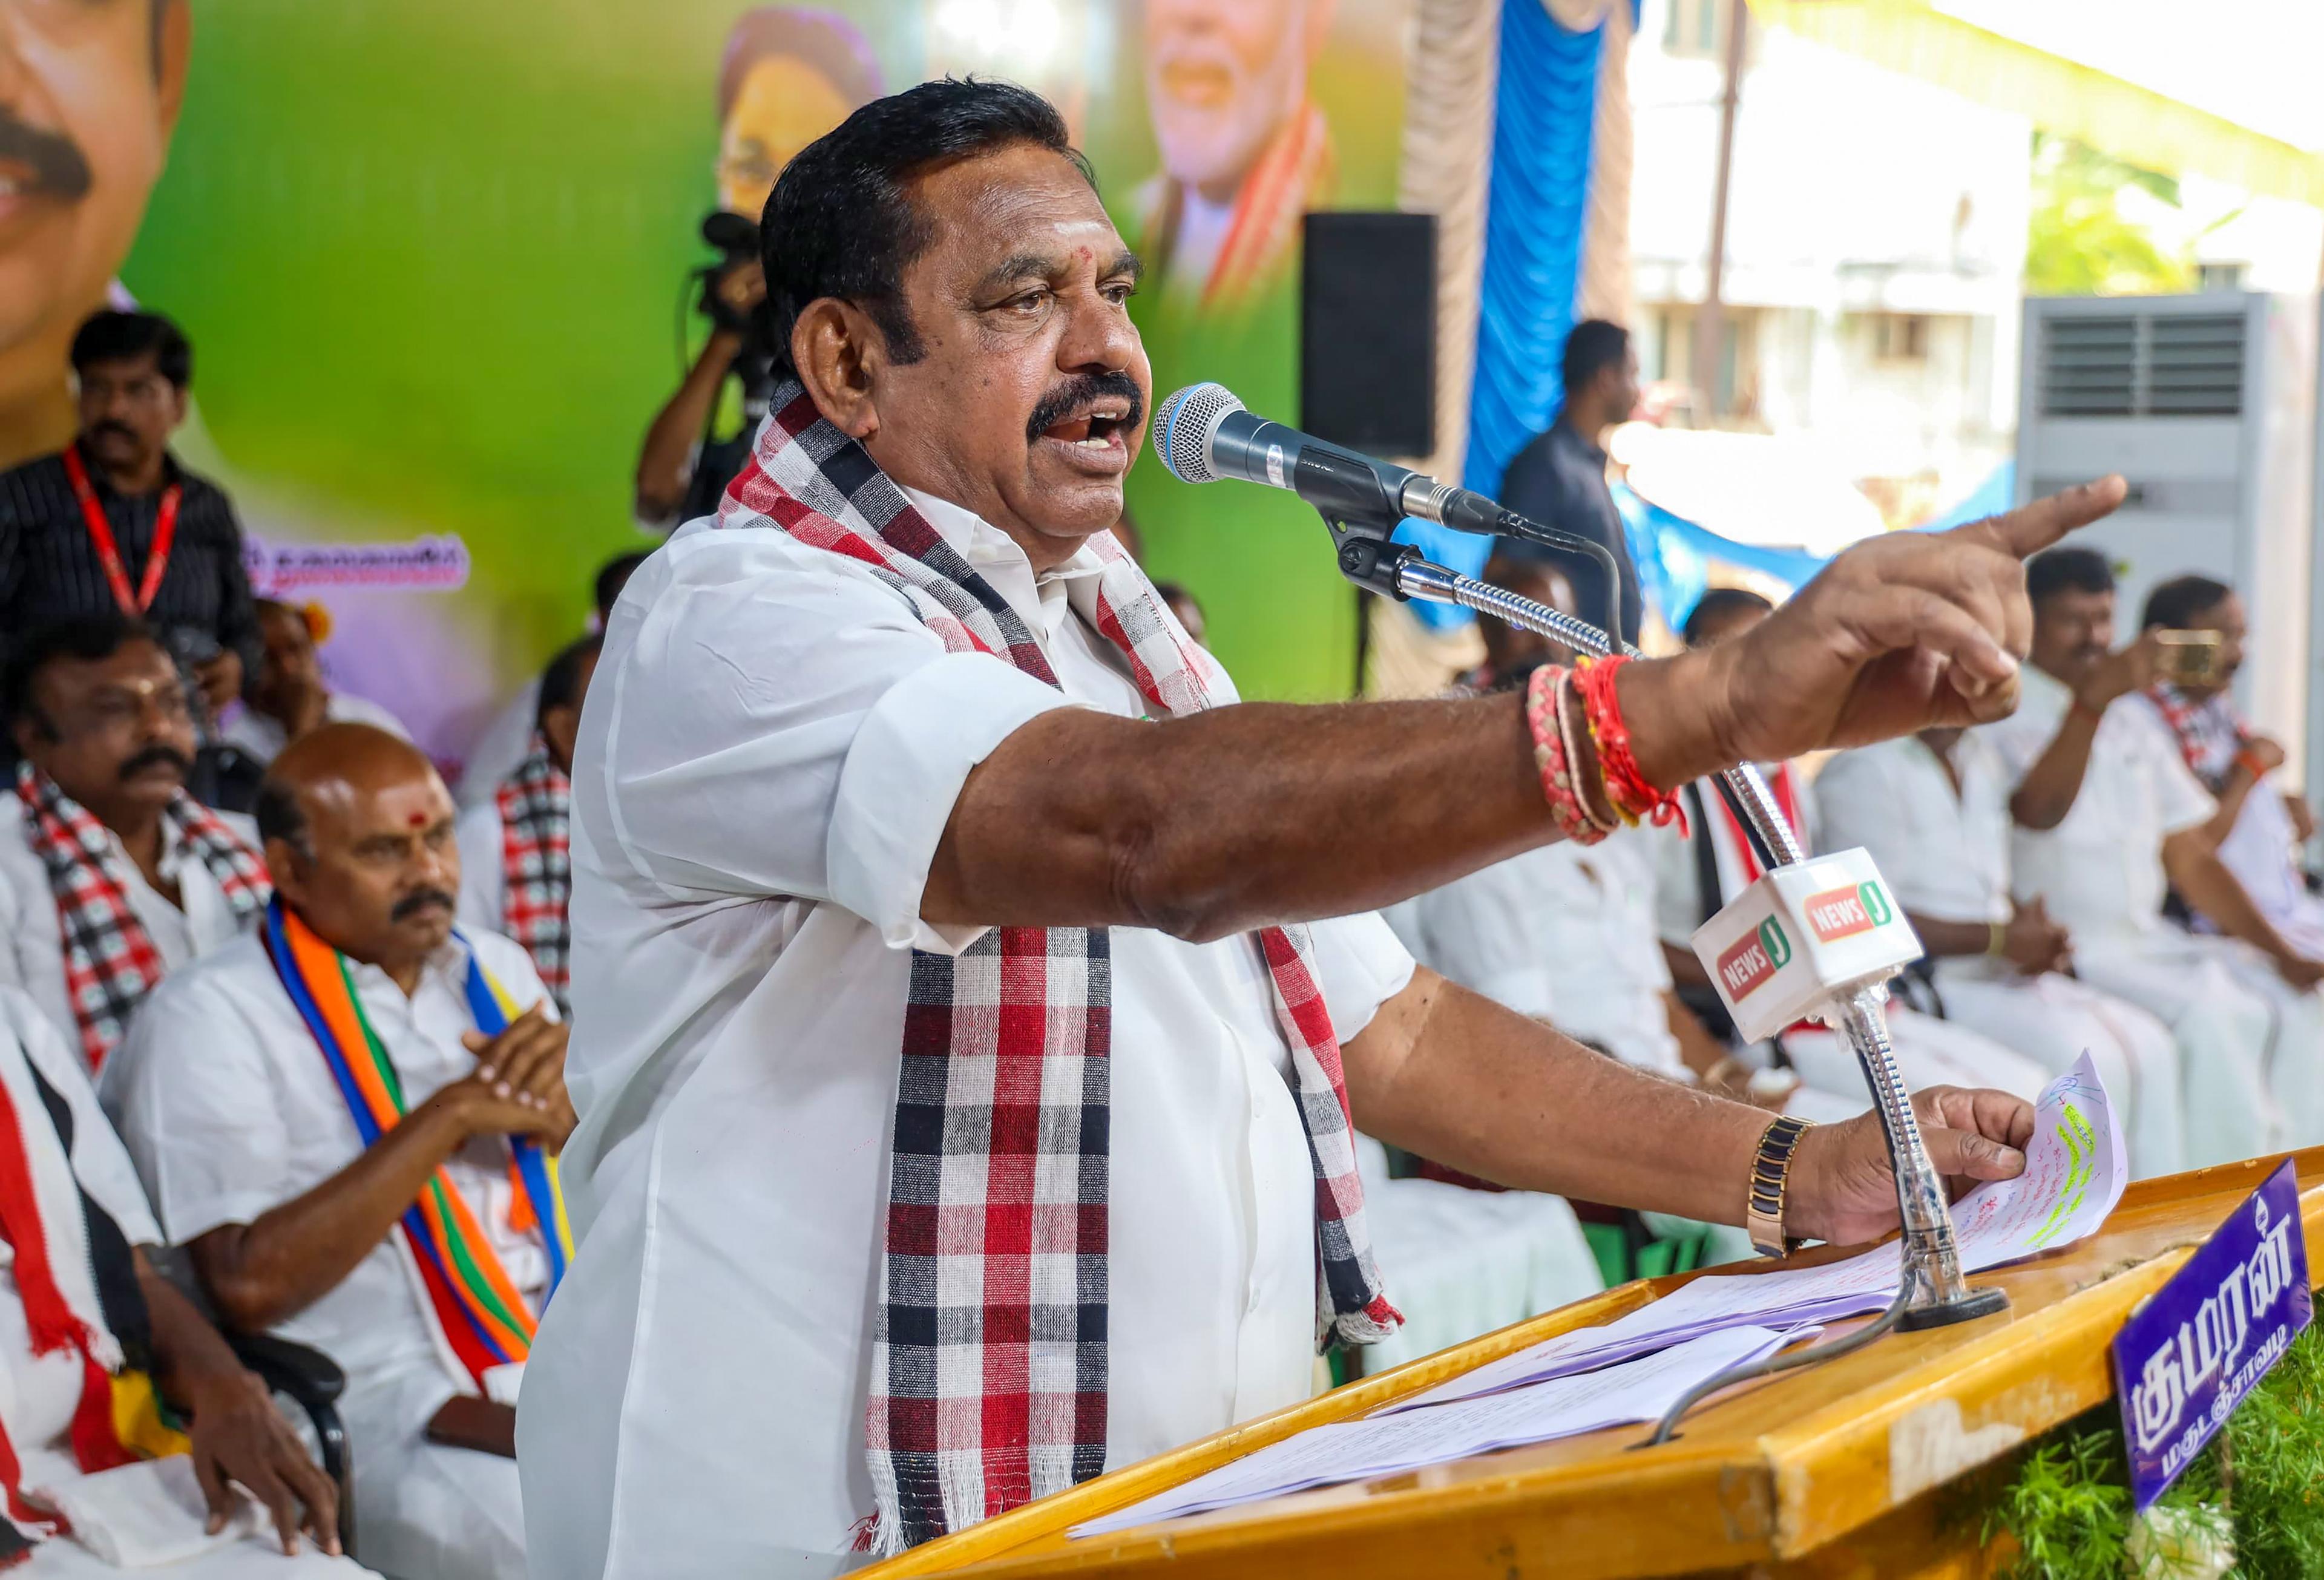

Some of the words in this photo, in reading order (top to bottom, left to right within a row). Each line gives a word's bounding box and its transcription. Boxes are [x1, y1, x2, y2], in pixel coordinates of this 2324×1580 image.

[1812, 897, 1865, 933] NEWS
[1866, 885, 1885, 922] J
[1723, 944, 1767, 991] NEWS
[1767, 922, 1786, 962] J
[2132, 1195, 2293, 1453] குமரன்
